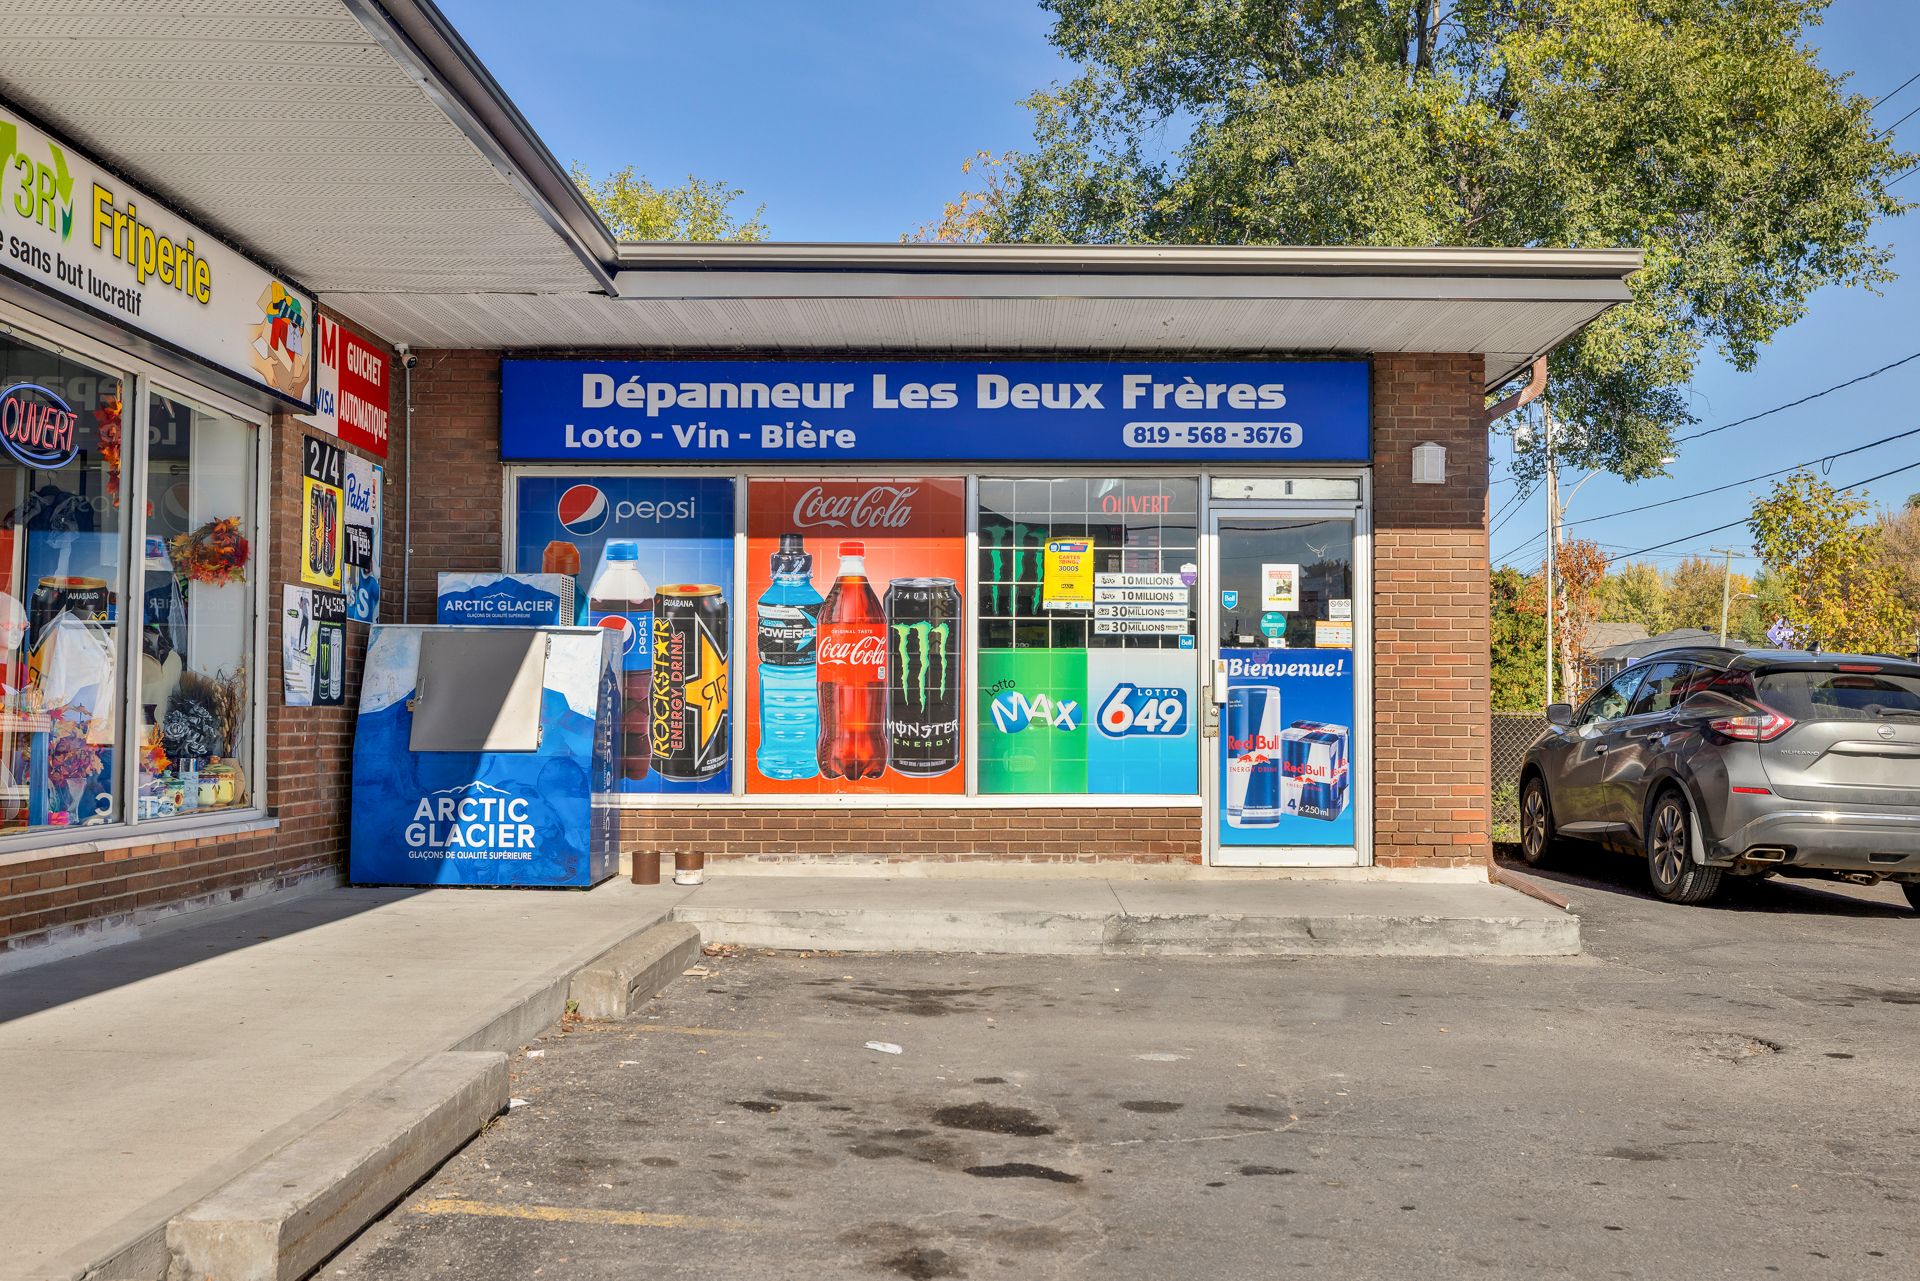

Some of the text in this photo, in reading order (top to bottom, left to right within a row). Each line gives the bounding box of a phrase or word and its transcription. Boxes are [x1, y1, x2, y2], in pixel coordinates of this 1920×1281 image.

[14, 152, 57, 233] 3R
[92, 182, 211, 305] Friperie
[10, 236, 51, 274] sans
[57, 252, 83, 290] but
[88, 268, 142, 316] lucratif
[347, 341, 382, 387] GUICHET
[316, 387, 334, 417] VISA
[582, 373, 1286, 417] Dépanneur Les Deux Frères
[2, 397, 78, 452] OUVERT
[340, 389, 388, 445] AUTOMATIQUE
[565, 424, 641, 448] Loto
[672, 422, 729, 448] Vin
[761, 420, 856, 448] Bière
[1133, 427, 1169, 444] 819
[1187, 427, 1226, 444] 568
[1243, 427, 1292, 444] 3676
[310, 441, 340, 485] 2/4
[347, 472, 370, 513] Pabst
[615, 497, 695, 523] pepsi
[793, 486, 919, 528] Coca-Cola
[1102, 495, 1172, 515] OUVERT
[1122, 576, 1134, 585] 10
[1135, 576, 1174, 586] MILLION$
[445, 600, 553, 611] ARCTIC GLACIER
[664, 599, 694, 607] GUARANA
[897, 591, 950, 600] TAURINE
[1122, 591, 1134, 600] 10
[1135, 592, 1174, 601] MILLION$
[1111, 606, 1127, 617] 30
[1128, 608, 1165, 616] MILLION$
[638, 615, 647, 654] pepsi
[759, 626, 816, 639] POWERAD
[1111, 621, 1127, 632] 30
[1128, 624, 1165, 632] MILLION$
[818, 636, 886, 665] Coca-Cola
[1181, 638, 1192, 646] Bell
[1228, 658, 1344, 677] Bienvenue!
[671, 632, 683, 749] ENERGY DRINK
[985, 678, 1016, 697] Lotto
[1137, 689, 1179, 697] LOTTO
[887, 719, 958, 739] MONSTER
[894, 738, 951, 748] ENERGY
[1228, 734, 1279, 750] Red Bull
[1283, 761, 1325, 777] Red Bull
[413, 797, 529, 822] ARCTIC
[1287, 798, 1297, 810] 4
[1305, 804, 1320, 815] 250
[1320, 808, 1329, 817] ml
[404, 823, 535, 848] GLACIER
[408, 850, 532, 860] GLAÇONS DE QUALITÉ SUPÉRIEURE
